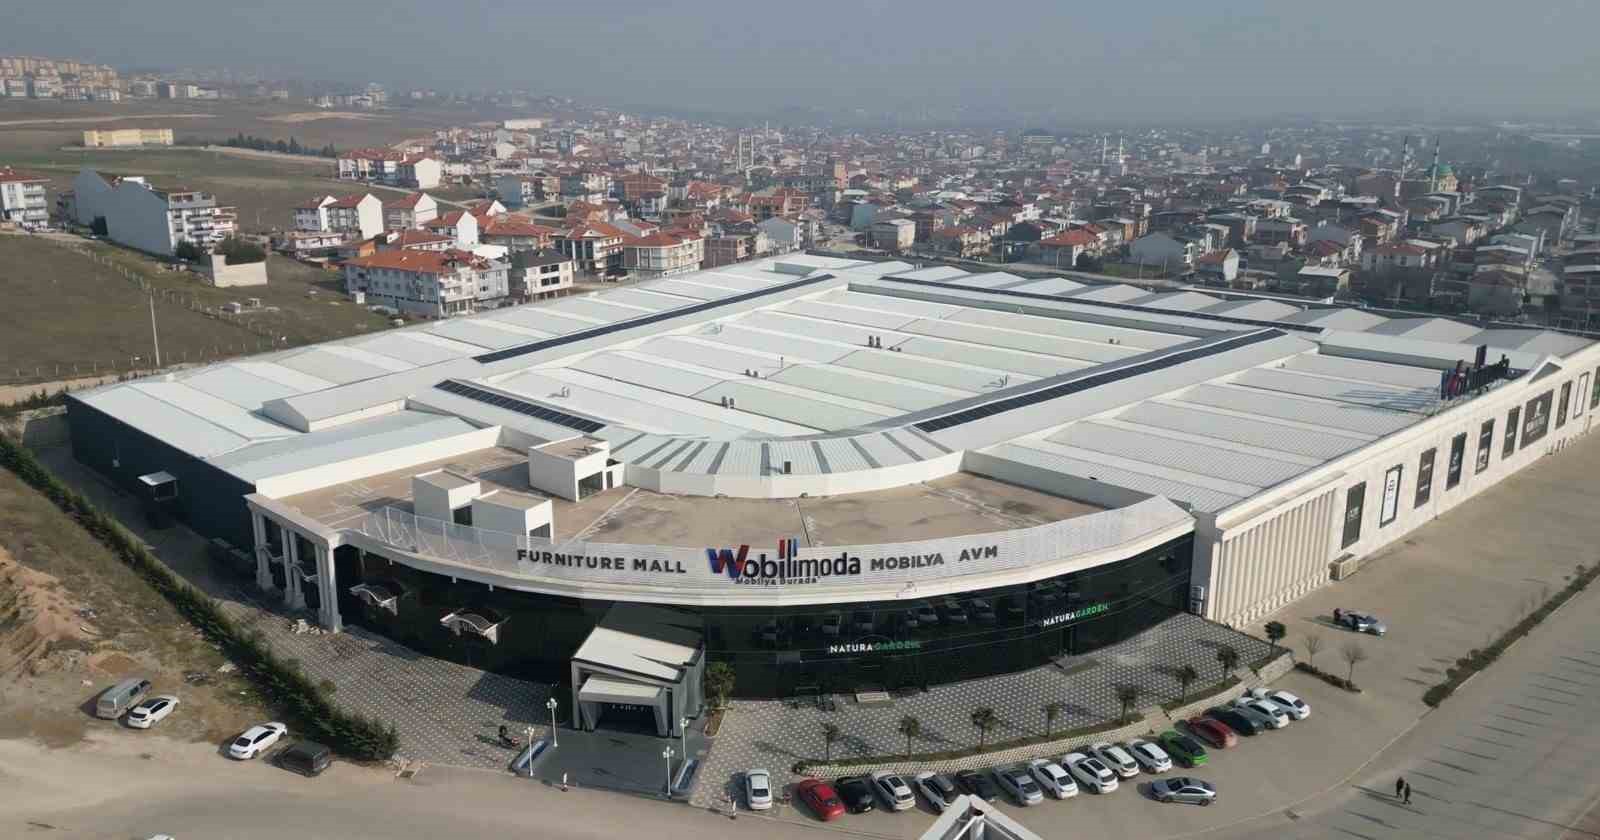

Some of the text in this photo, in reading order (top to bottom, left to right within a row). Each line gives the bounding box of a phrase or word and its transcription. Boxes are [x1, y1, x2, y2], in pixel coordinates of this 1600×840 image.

[516, 549, 687, 573] FURNITURE MALL
[706, 538, 861, 579] Wobilimoda
[959, 545, 998, 561] AVM
